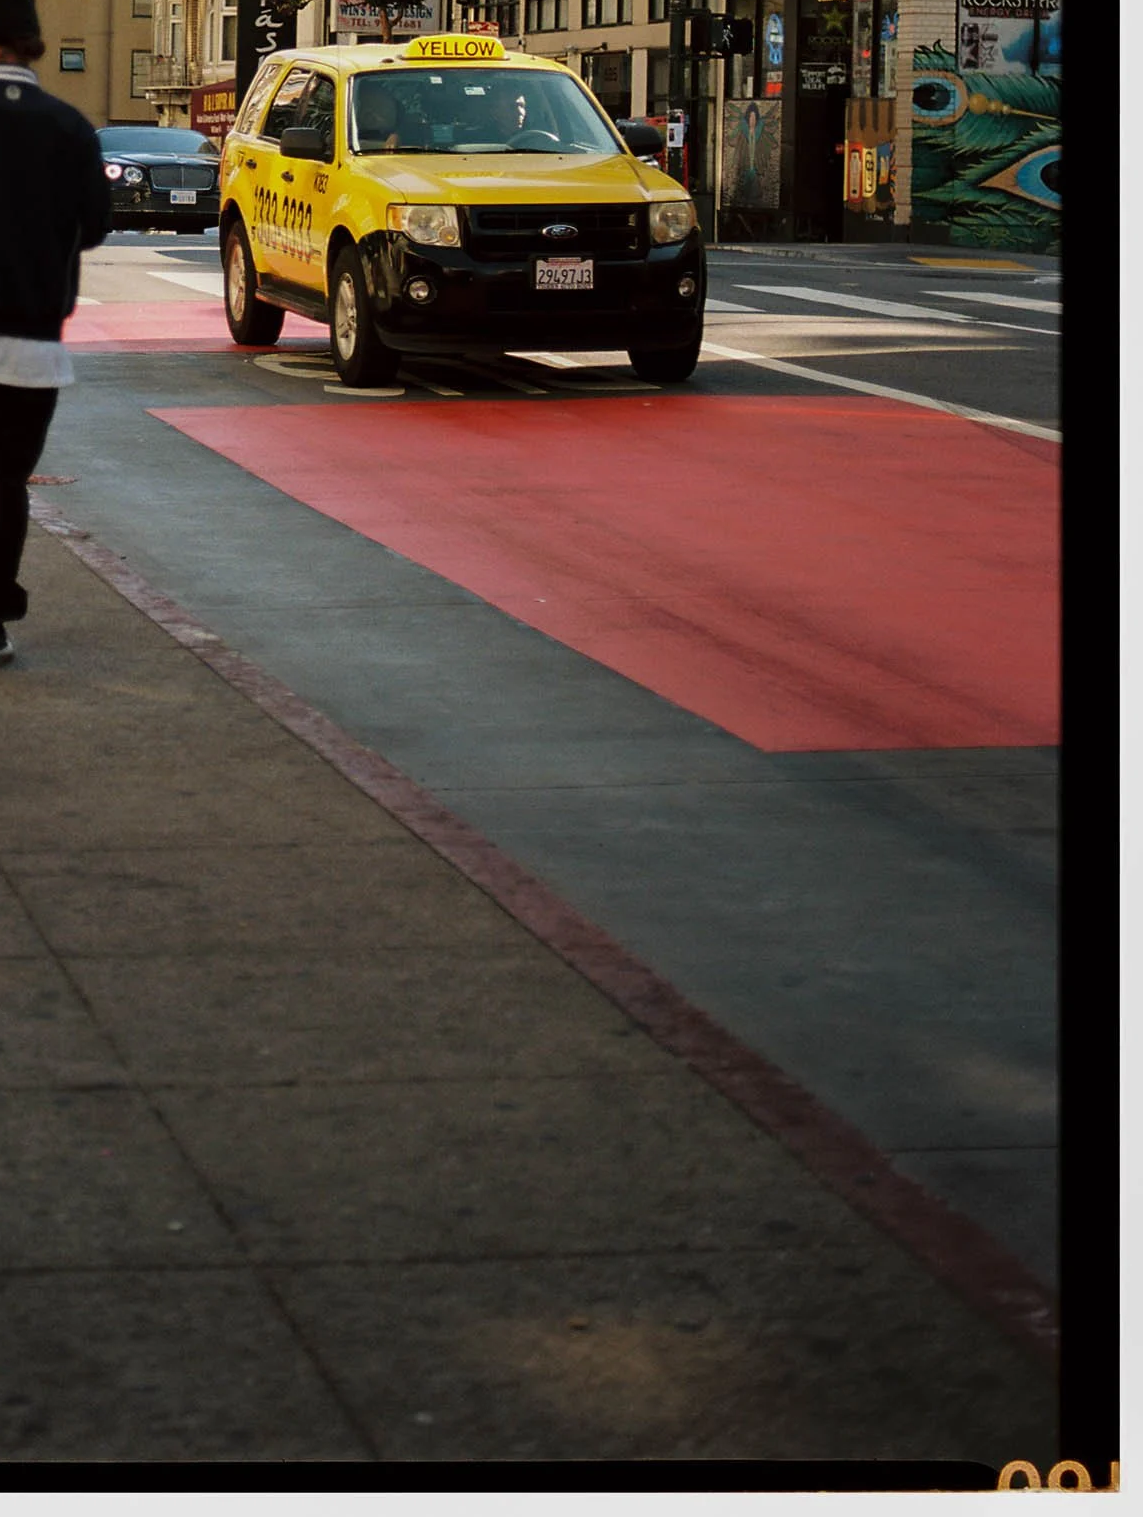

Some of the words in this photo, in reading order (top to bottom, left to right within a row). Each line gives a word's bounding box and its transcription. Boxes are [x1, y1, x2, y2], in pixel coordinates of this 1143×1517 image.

[399, 7, 434, 19] ESIGN
[418, 41, 495, 56] YELLOW
[539, 269, 592, 284] 29497J3
